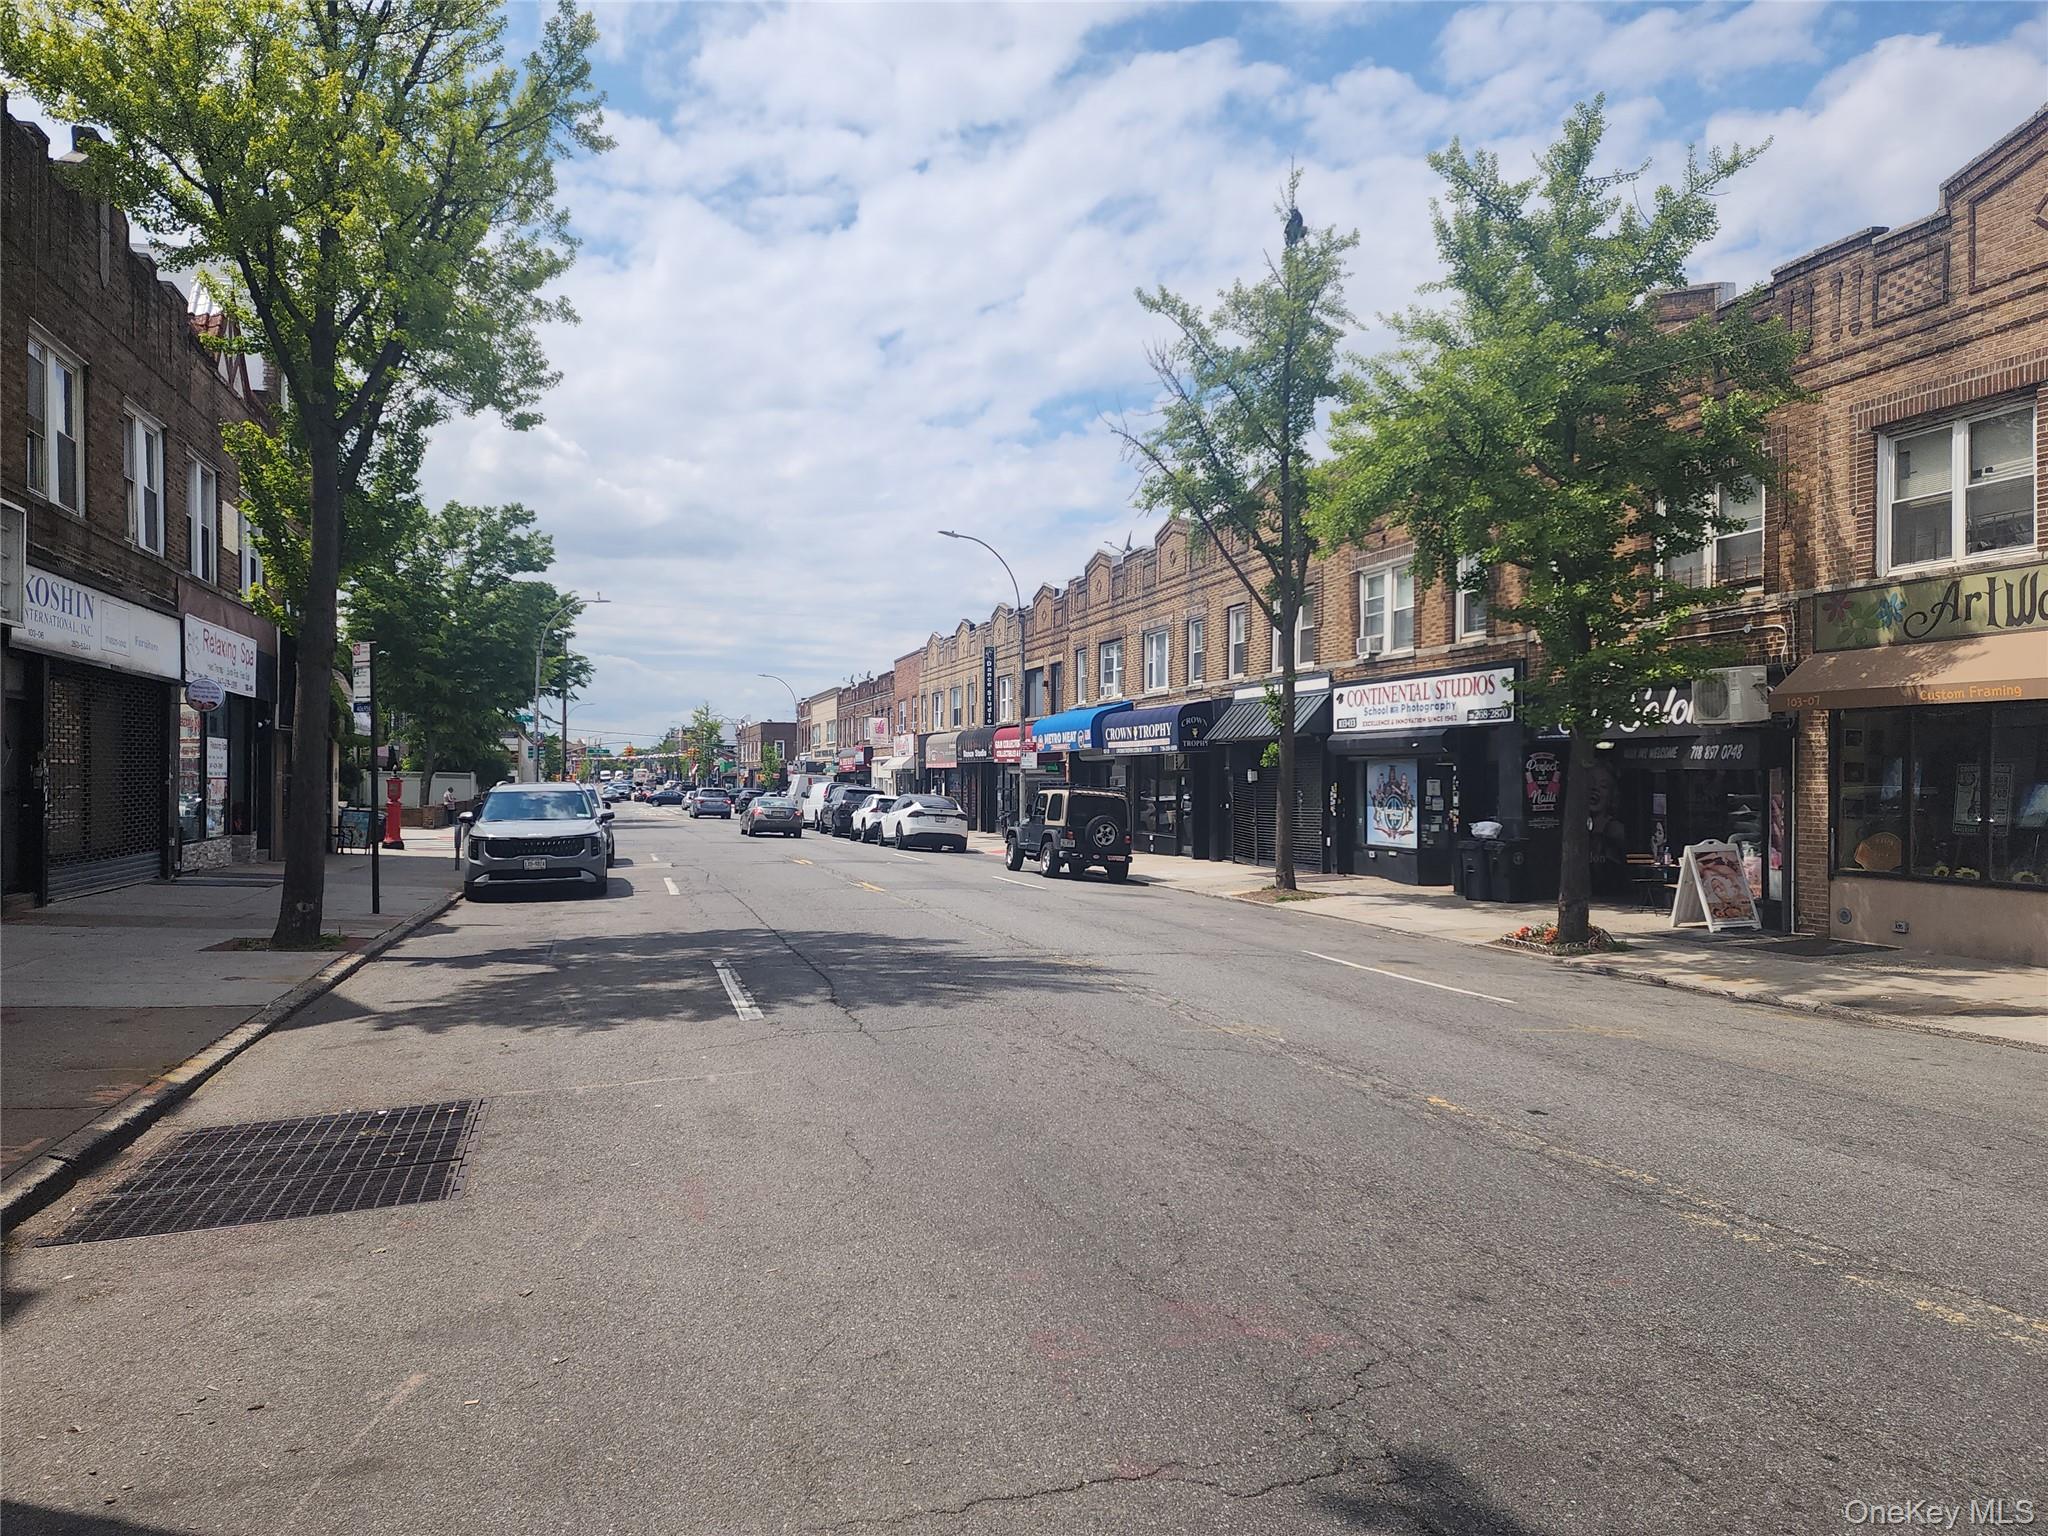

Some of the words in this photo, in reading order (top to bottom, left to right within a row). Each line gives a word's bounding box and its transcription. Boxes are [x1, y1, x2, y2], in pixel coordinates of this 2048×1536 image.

[26, 574, 95, 622] KOSHIN
[202, 627, 237, 667] Relaxing
[240, 641, 254, 669] Spa
[985, 660, 994, 687] Dance
[1347, 681, 1431, 708] CONTINENTAL
[1435, 673, 1497, 700] STUDIOS
[1919, 687, 1965, 701] Custom
[1969, 684, 2022, 699] Framing
[985, 690, 994, 724] Studio
[1363, 705, 1389, 716] School
[1400, 700, 1457, 714] Photography
[1786, 695, 1821, 709] 103-07
[1181, 716, 1208, 728] CROWN
[1427, 715, 1444, 723] SINCE
[1044, 732, 1062, 745] METRO
[1062, 730, 1077, 743] MEAT
[1105, 725, 1133, 741] CROWN
[1138, 721, 1173, 739] TROPHY
[1182, 739, 1209, 747] TROPHY
[1689, 745, 1703, 760] 718
[1720, 743, 1745, 760] 0748
[1526, 759, 1560, 774] Perfect
[1531, 789, 1557, 805] Nails
